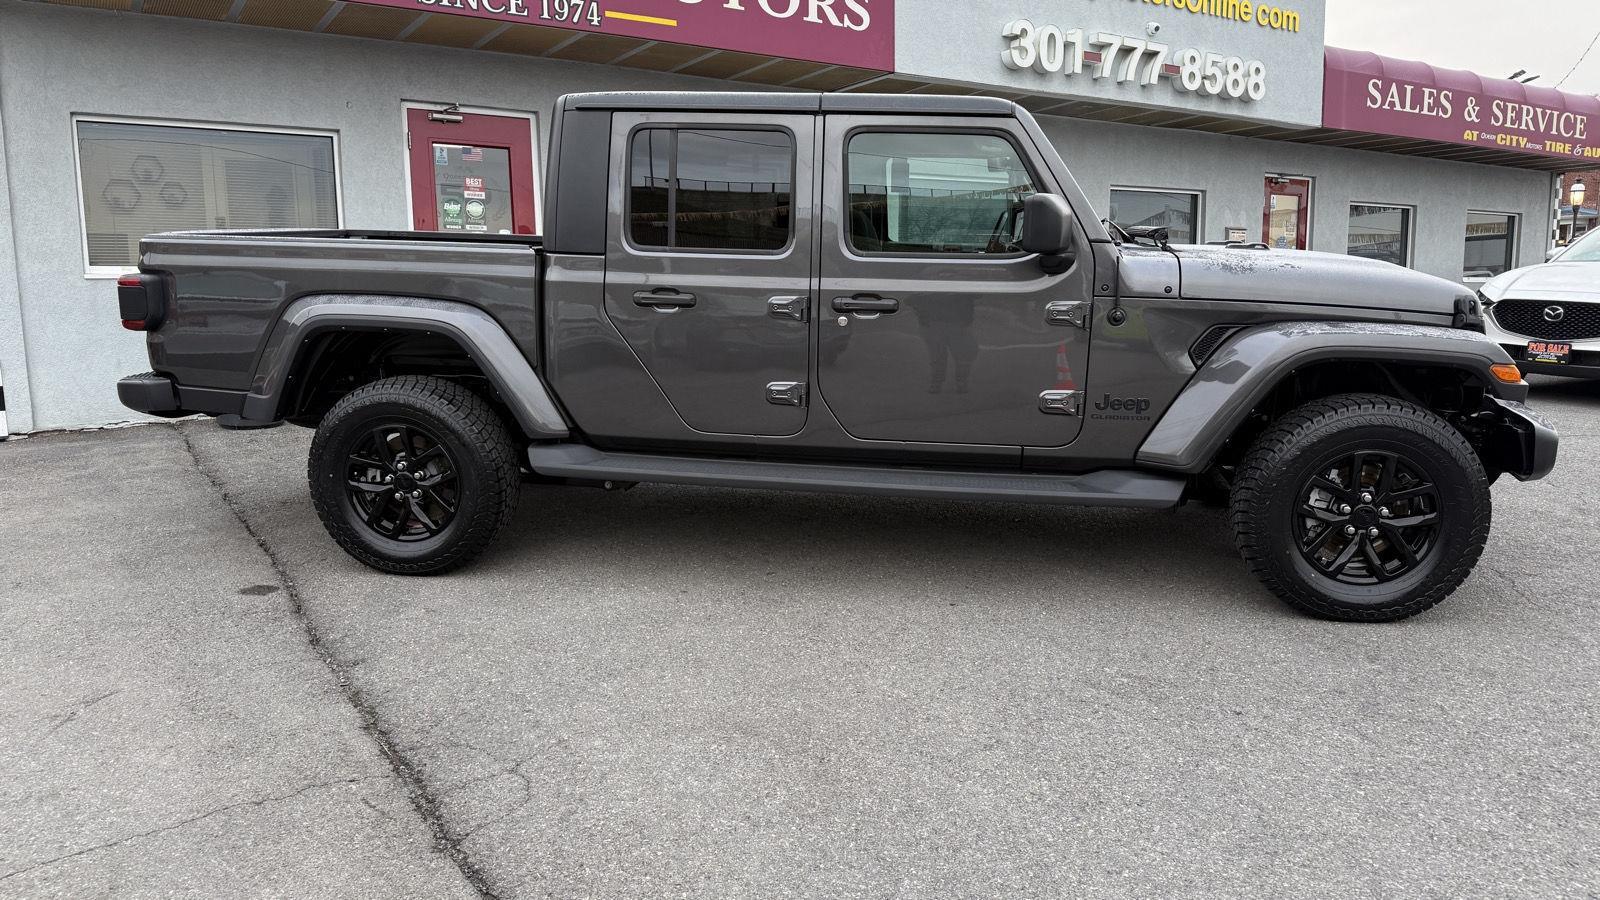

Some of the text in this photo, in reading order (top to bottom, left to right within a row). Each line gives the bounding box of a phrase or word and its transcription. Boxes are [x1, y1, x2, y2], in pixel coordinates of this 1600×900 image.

[540, 0, 602, 26] 1974
[1001, 18, 1266, 102] 301-777-8588
[1366, 78, 1588, 139] SALES & SERVICE
[1463, 129, 1479, 141] AT
[1496, 133, 1527, 148] CITY
[1544, 140, 1573, 154] TIRE
[1573, 143, 1584, 156] &
[465, 177, 482, 185] BEST
[1528, 342, 1546, 352] FOR
[1547, 344, 1569, 354] SALE
[1095, 393, 1150, 414] Jeep
